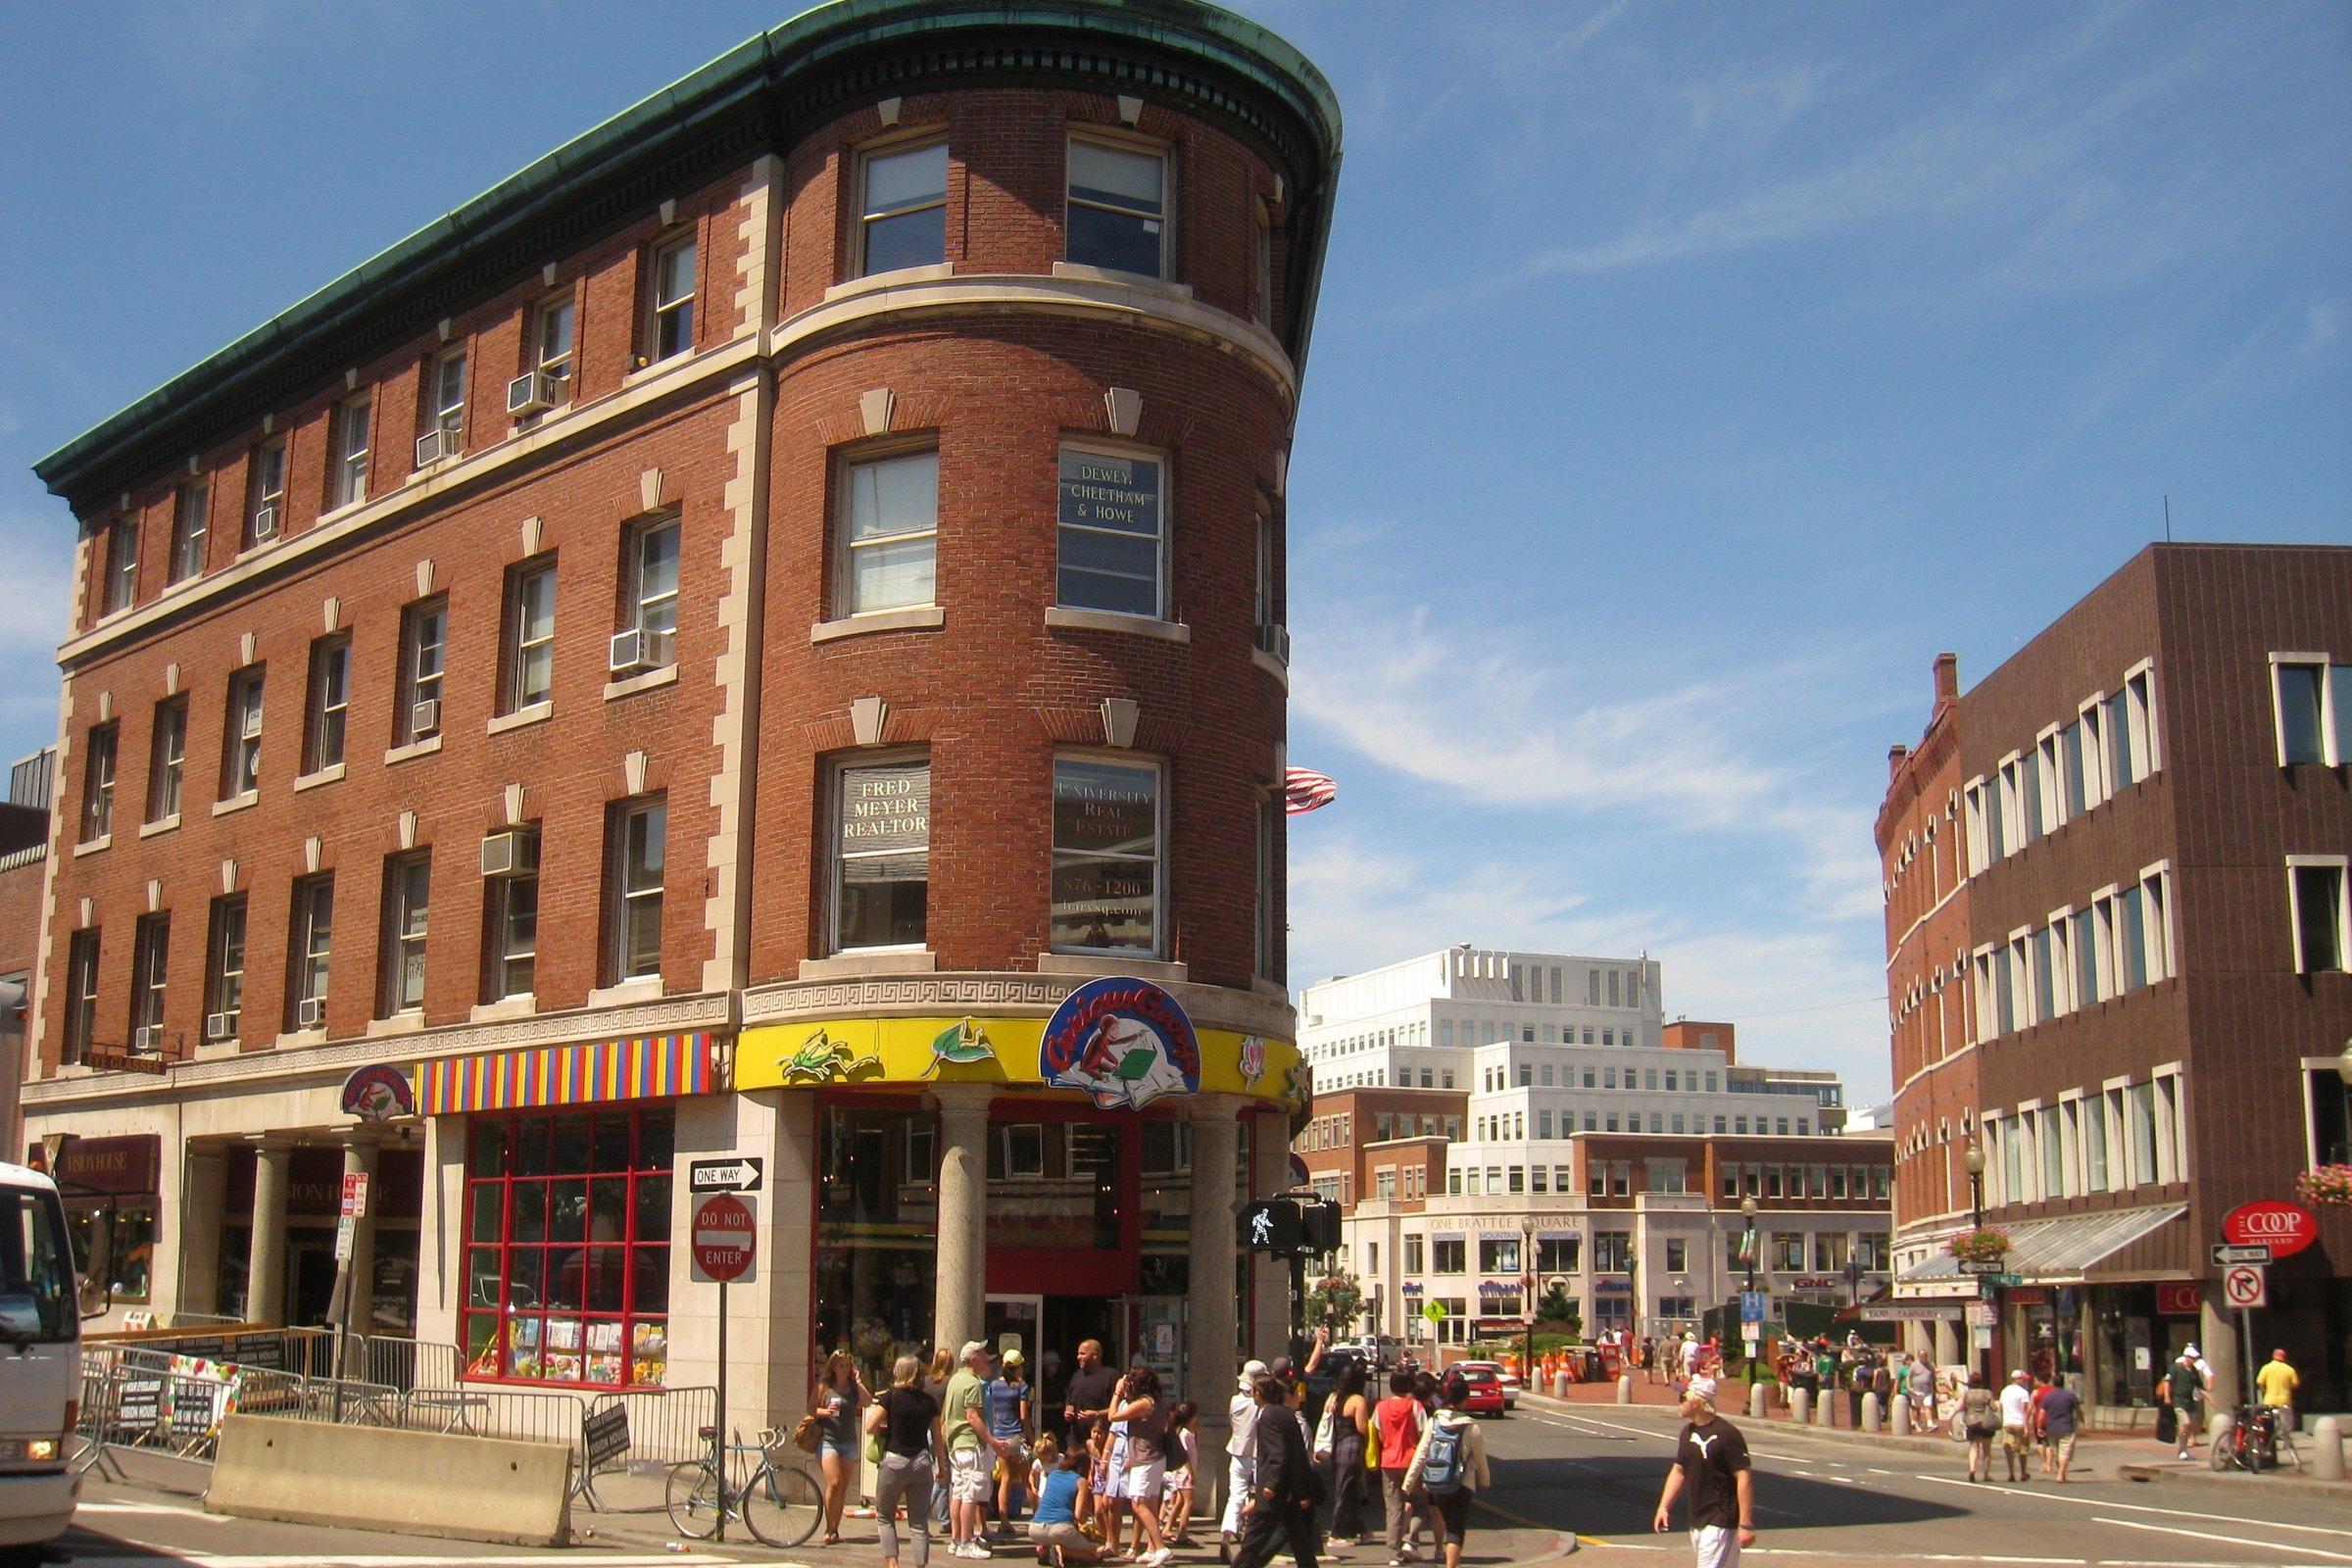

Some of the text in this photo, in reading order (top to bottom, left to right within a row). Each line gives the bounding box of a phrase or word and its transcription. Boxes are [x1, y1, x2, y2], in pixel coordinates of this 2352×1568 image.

[1082, 466, 1132, 485] DEWEY,
[1071, 484, 1145, 506] CHEETHAM
[1077, 503, 1134, 523] & HOWE
[862, 779, 911, 797] FRED
[1057, 782, 1150, 804] UNIVERSITY
[855, 798, 919, 817] MEYER
[1084, 802, 1122, 819] REAL
[844, 816, 927, 838] REALTOR
[1076, 819, 1131, 837] ESTATE
[1063, 899, 1142, 917] harvsq.com
[1048, 987, 1200, 1075] Curious George
[87, 1053, 161, 1074] EYE GLASSES
[697, 1168, 741, 1183] ONE WAY
[702, 1211, 747, 1226] DO NOT
[1431, 1218, 1452, 1230] ONE
[1458, 1216, 1513, 1229] BRATTLE
[2247, 1211, 2302, 1234] COOP
[706, 1250, 742, 1265] ENTER
[1793, 1278, 1837, 1289] GNC
